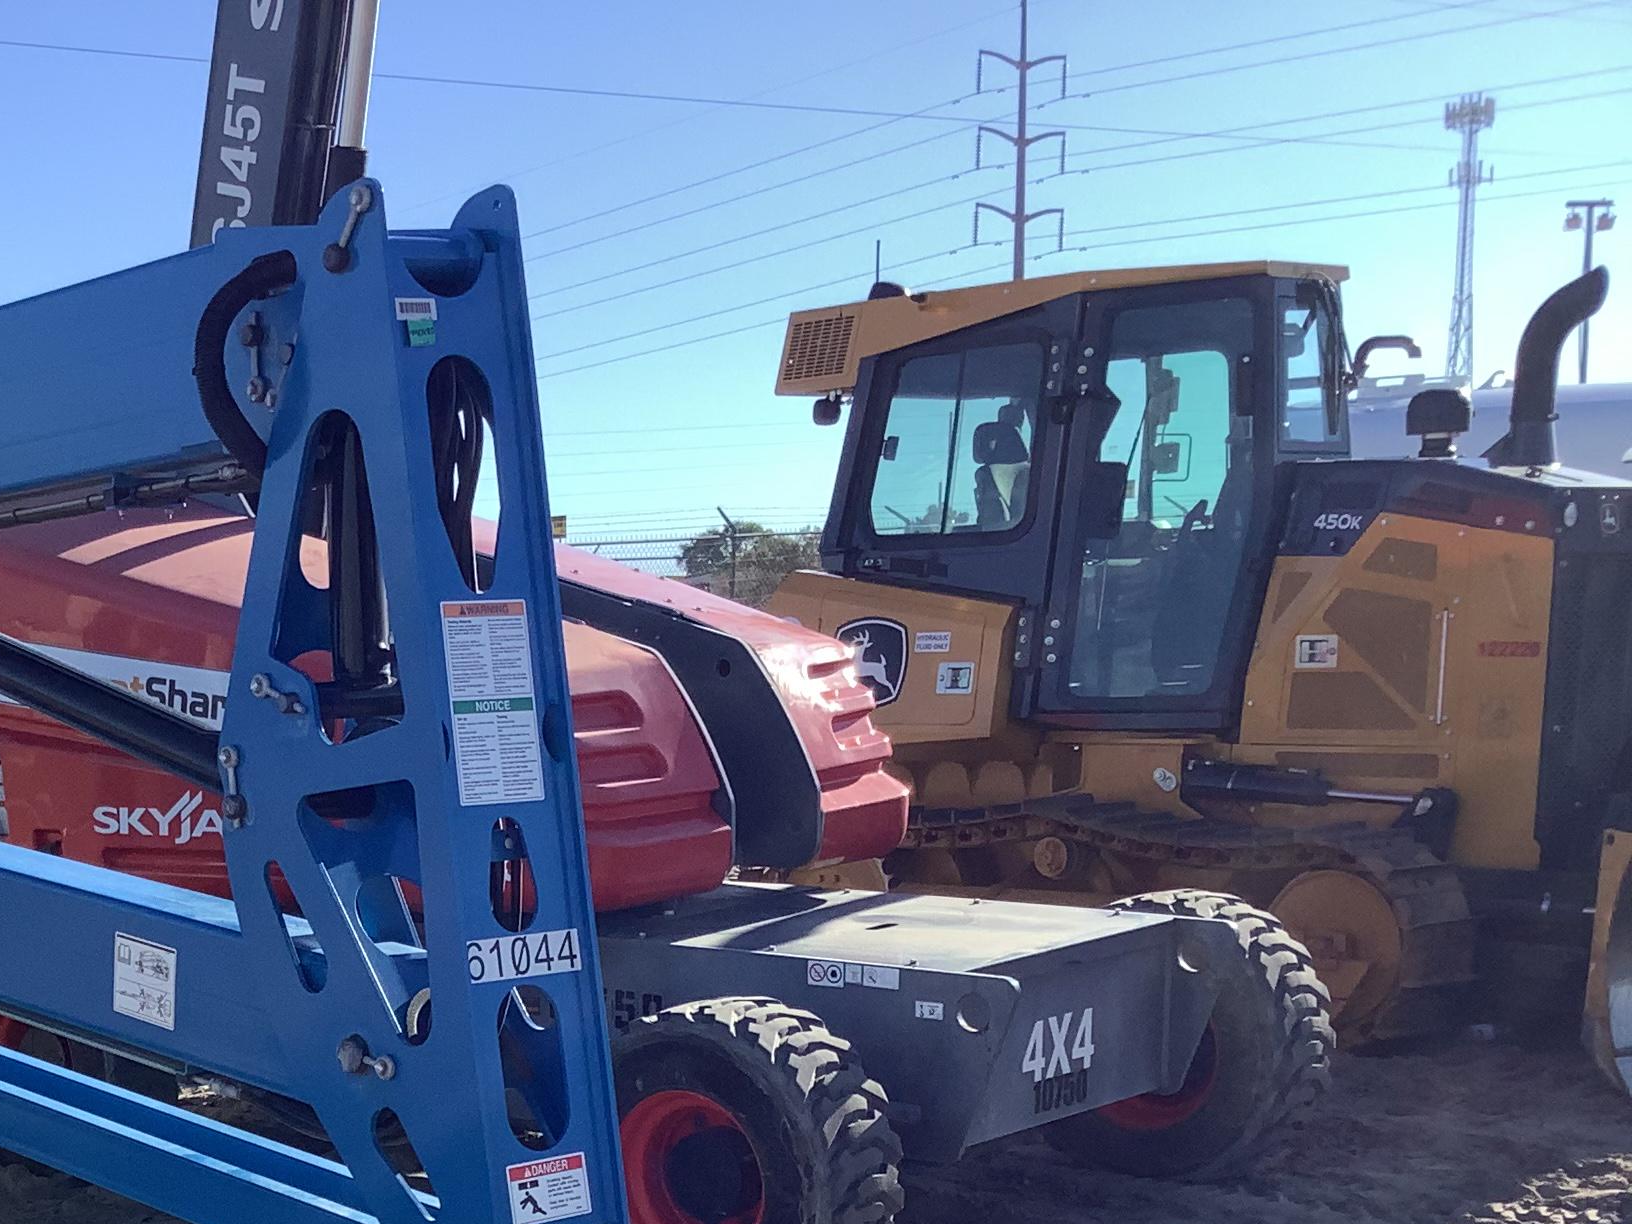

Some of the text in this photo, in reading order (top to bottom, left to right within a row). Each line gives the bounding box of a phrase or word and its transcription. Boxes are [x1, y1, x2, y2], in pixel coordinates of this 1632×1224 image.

[465, 603, 510, 615] WARNING
[474, 700, 511, 712] NOTICE
[468, 930, 578, 981] 61044
[1022, 1007, 1095, 1083] 4X4
[531, 1159, 569, 1177] DANGER
